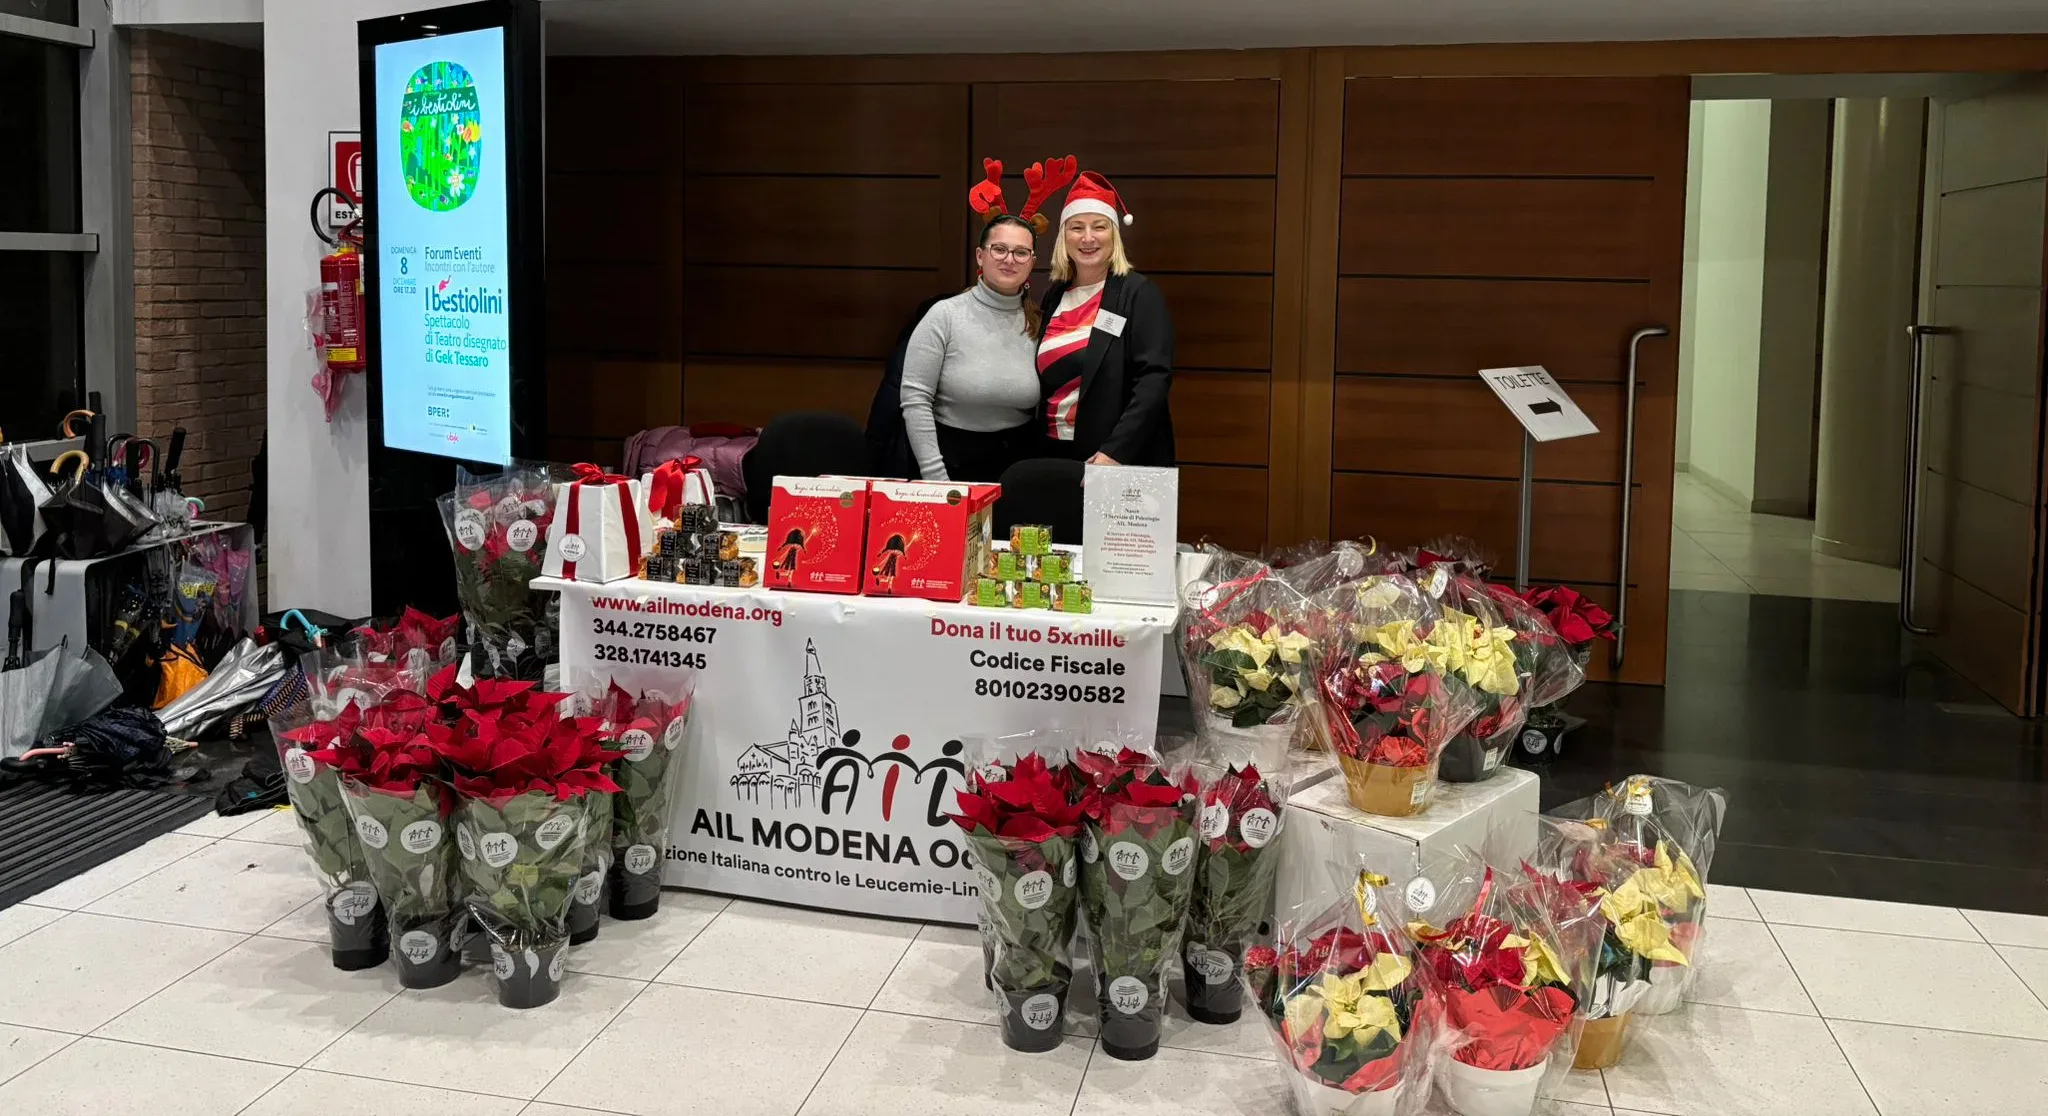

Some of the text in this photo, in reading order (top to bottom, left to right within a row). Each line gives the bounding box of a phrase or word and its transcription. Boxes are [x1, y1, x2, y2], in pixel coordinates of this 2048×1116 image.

[335, 211, 357, 219] EST
[391, 246, 416, 254] DOMENICA
[425, 246, 482, 260] Forum Eventi
[400, 256, 408, 275] 8
[425, 261, 495, 274] Incontri con l'autore
[393, 286, 404, 294] ORE
[425, 286, 502, 314] I bestiolini
[424, 313, 470, 330] Spettacolo
[425, 332, 506, 353] di Teatro disegnato
[426, 348, 489, 368] di Gek Tessaro
[1494, 372, 1550, 390] TOILETTE
[592, 596, 783, 626] www.ailmodena.org
[593, 618, 717, 644] 344.2758467
[931, 618, 1127, 648] Dona il tuo 5xmille
[594, 644, 707, 670] 328.1741345
[970, 650, 1126, 676] Codice Fiscale
[974, 678, 1126, 704] 80102390582
[817, 728, 965, 828] AIL
[690, 808, 744, 843] AIL
[752, 817, 921, 866] MODENA
[712, 855, 770, 876] Italiana
[774, 864, 832, 884] contro
[835, 870, 851, 886] le
